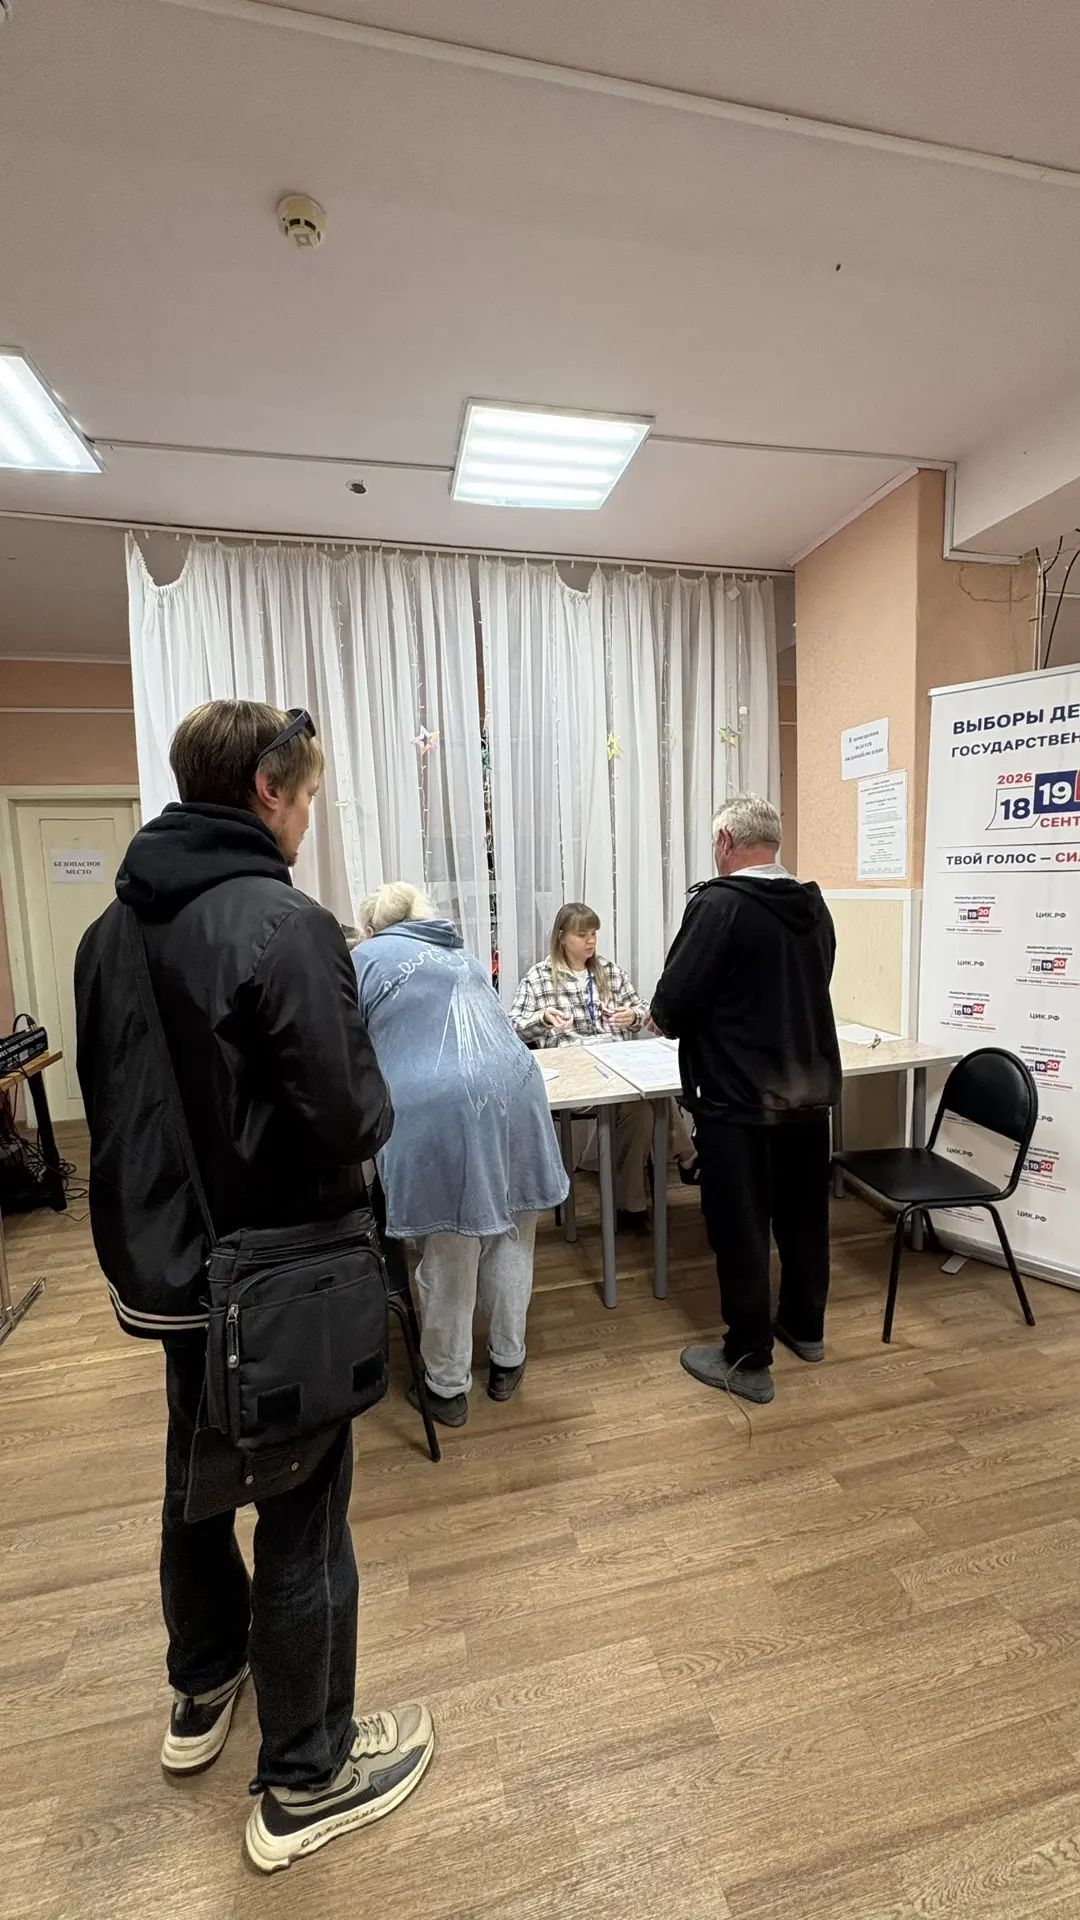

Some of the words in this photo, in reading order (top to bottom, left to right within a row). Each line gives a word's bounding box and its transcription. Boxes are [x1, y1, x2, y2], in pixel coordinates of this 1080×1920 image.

[953, 709, 1044, 735] ВЫБОРЫ
[997, 772, 1032, 785] 2026
[1000, 797, 1031, 820] 18
[1038, 781, 1072, 805] 19
[946, 852, 982, 865] ТВОЙ
[986, 853, 1036, 864] ГОЛОС
[1055, 852, 1080, 862] СИ
[978, 908, 989, 916] 20
[1029, 1013, 1060, 1021] ЦИК.РФ
[1047, 1061, 1059, 1069] 20
[1041, 1161, 1052, 1169] 20
[1017, 1210, 1047, 1222] ЦИК.РФ
